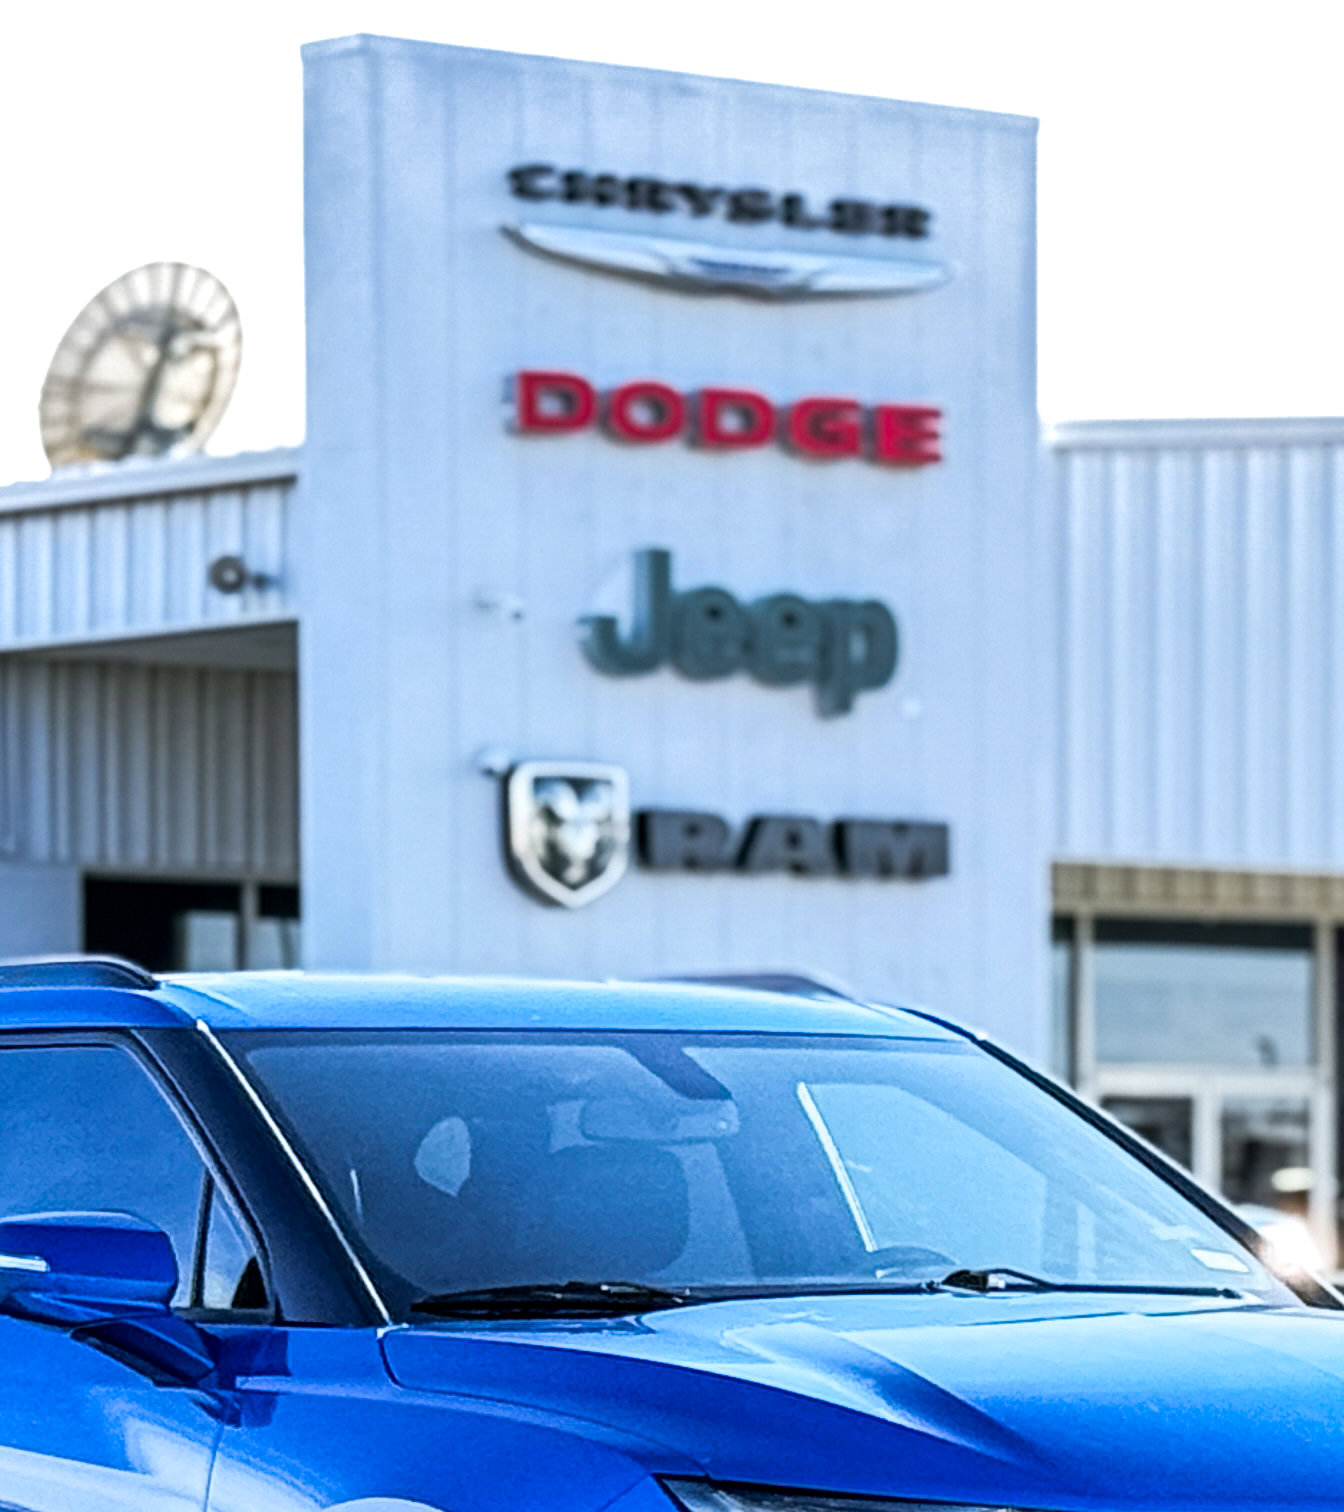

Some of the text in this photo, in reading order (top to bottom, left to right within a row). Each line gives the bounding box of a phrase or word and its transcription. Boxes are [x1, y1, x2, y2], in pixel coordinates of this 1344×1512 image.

[506, 163, 932, 240] CHRYSLER
[506, 369, 944, 467] DODGE
[577, 548, 900, 719] Jeep
[631, 808, 950, 882] RAM
